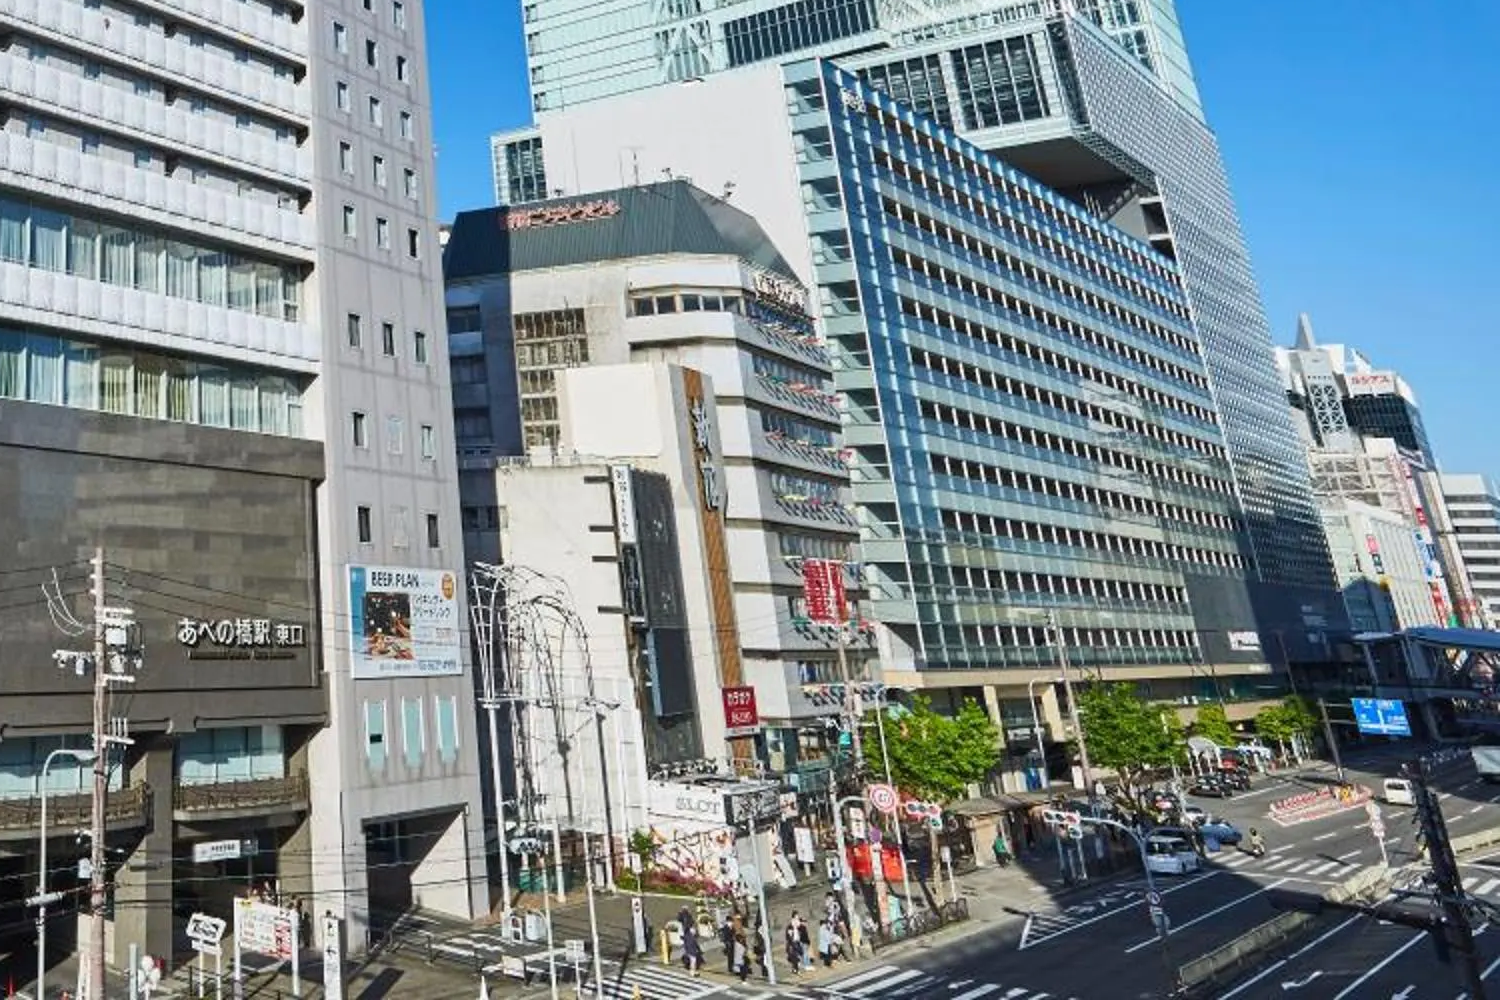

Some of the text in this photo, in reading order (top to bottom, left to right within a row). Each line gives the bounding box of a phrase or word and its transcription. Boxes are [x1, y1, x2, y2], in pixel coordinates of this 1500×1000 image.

[371, 571, 419, 588] BEER PLAN
[177, 617, 304, 646] あべの橋駅 東口
